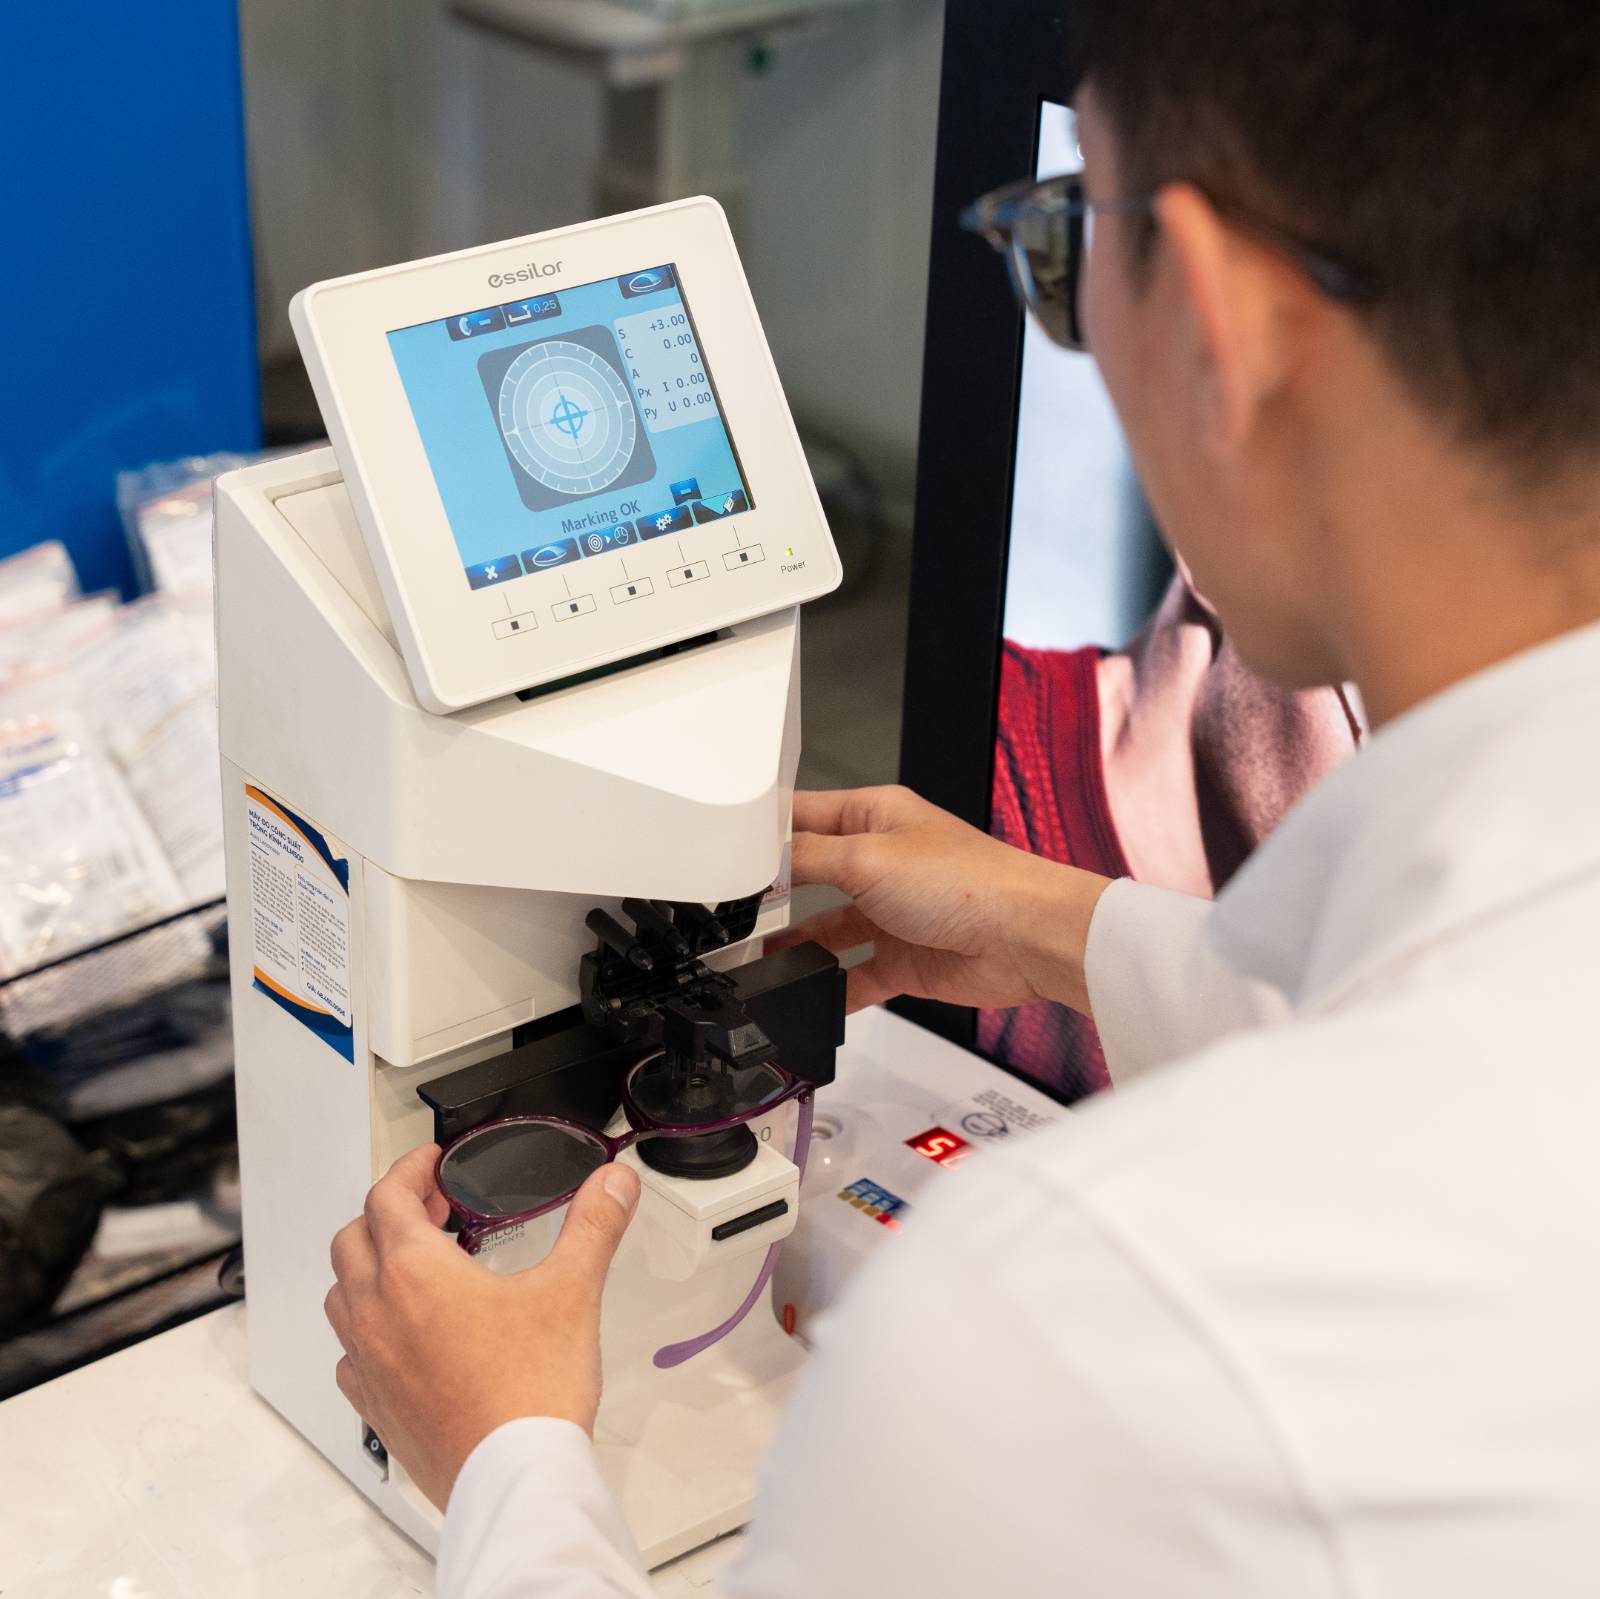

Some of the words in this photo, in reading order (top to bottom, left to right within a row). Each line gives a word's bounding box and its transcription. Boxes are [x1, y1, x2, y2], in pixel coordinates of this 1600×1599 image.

[488, 260, 563, 288] essilor
[618, 328, 626, 340] S
[650, 313, 686, 332] +3.00
[624, 348, 634, 359] C
[663, 333, 692, 350] 0.00
[632, 368, 641, 380] A
[690, 352, 699, 364] 0
[637, 387, 652, 399] Px
[676, 372, 706, 389] 0.00
[644, 407, 658, 420] Py
[668, 401, 677, 412] U
[682, 391, 712, 408] 0.00
[560, 510, 619, 534] Marking
[620, 500, 641, 516] OK
[780, 561, 806, 574] Power
[480, 1222, 524, 1246] SILOR
